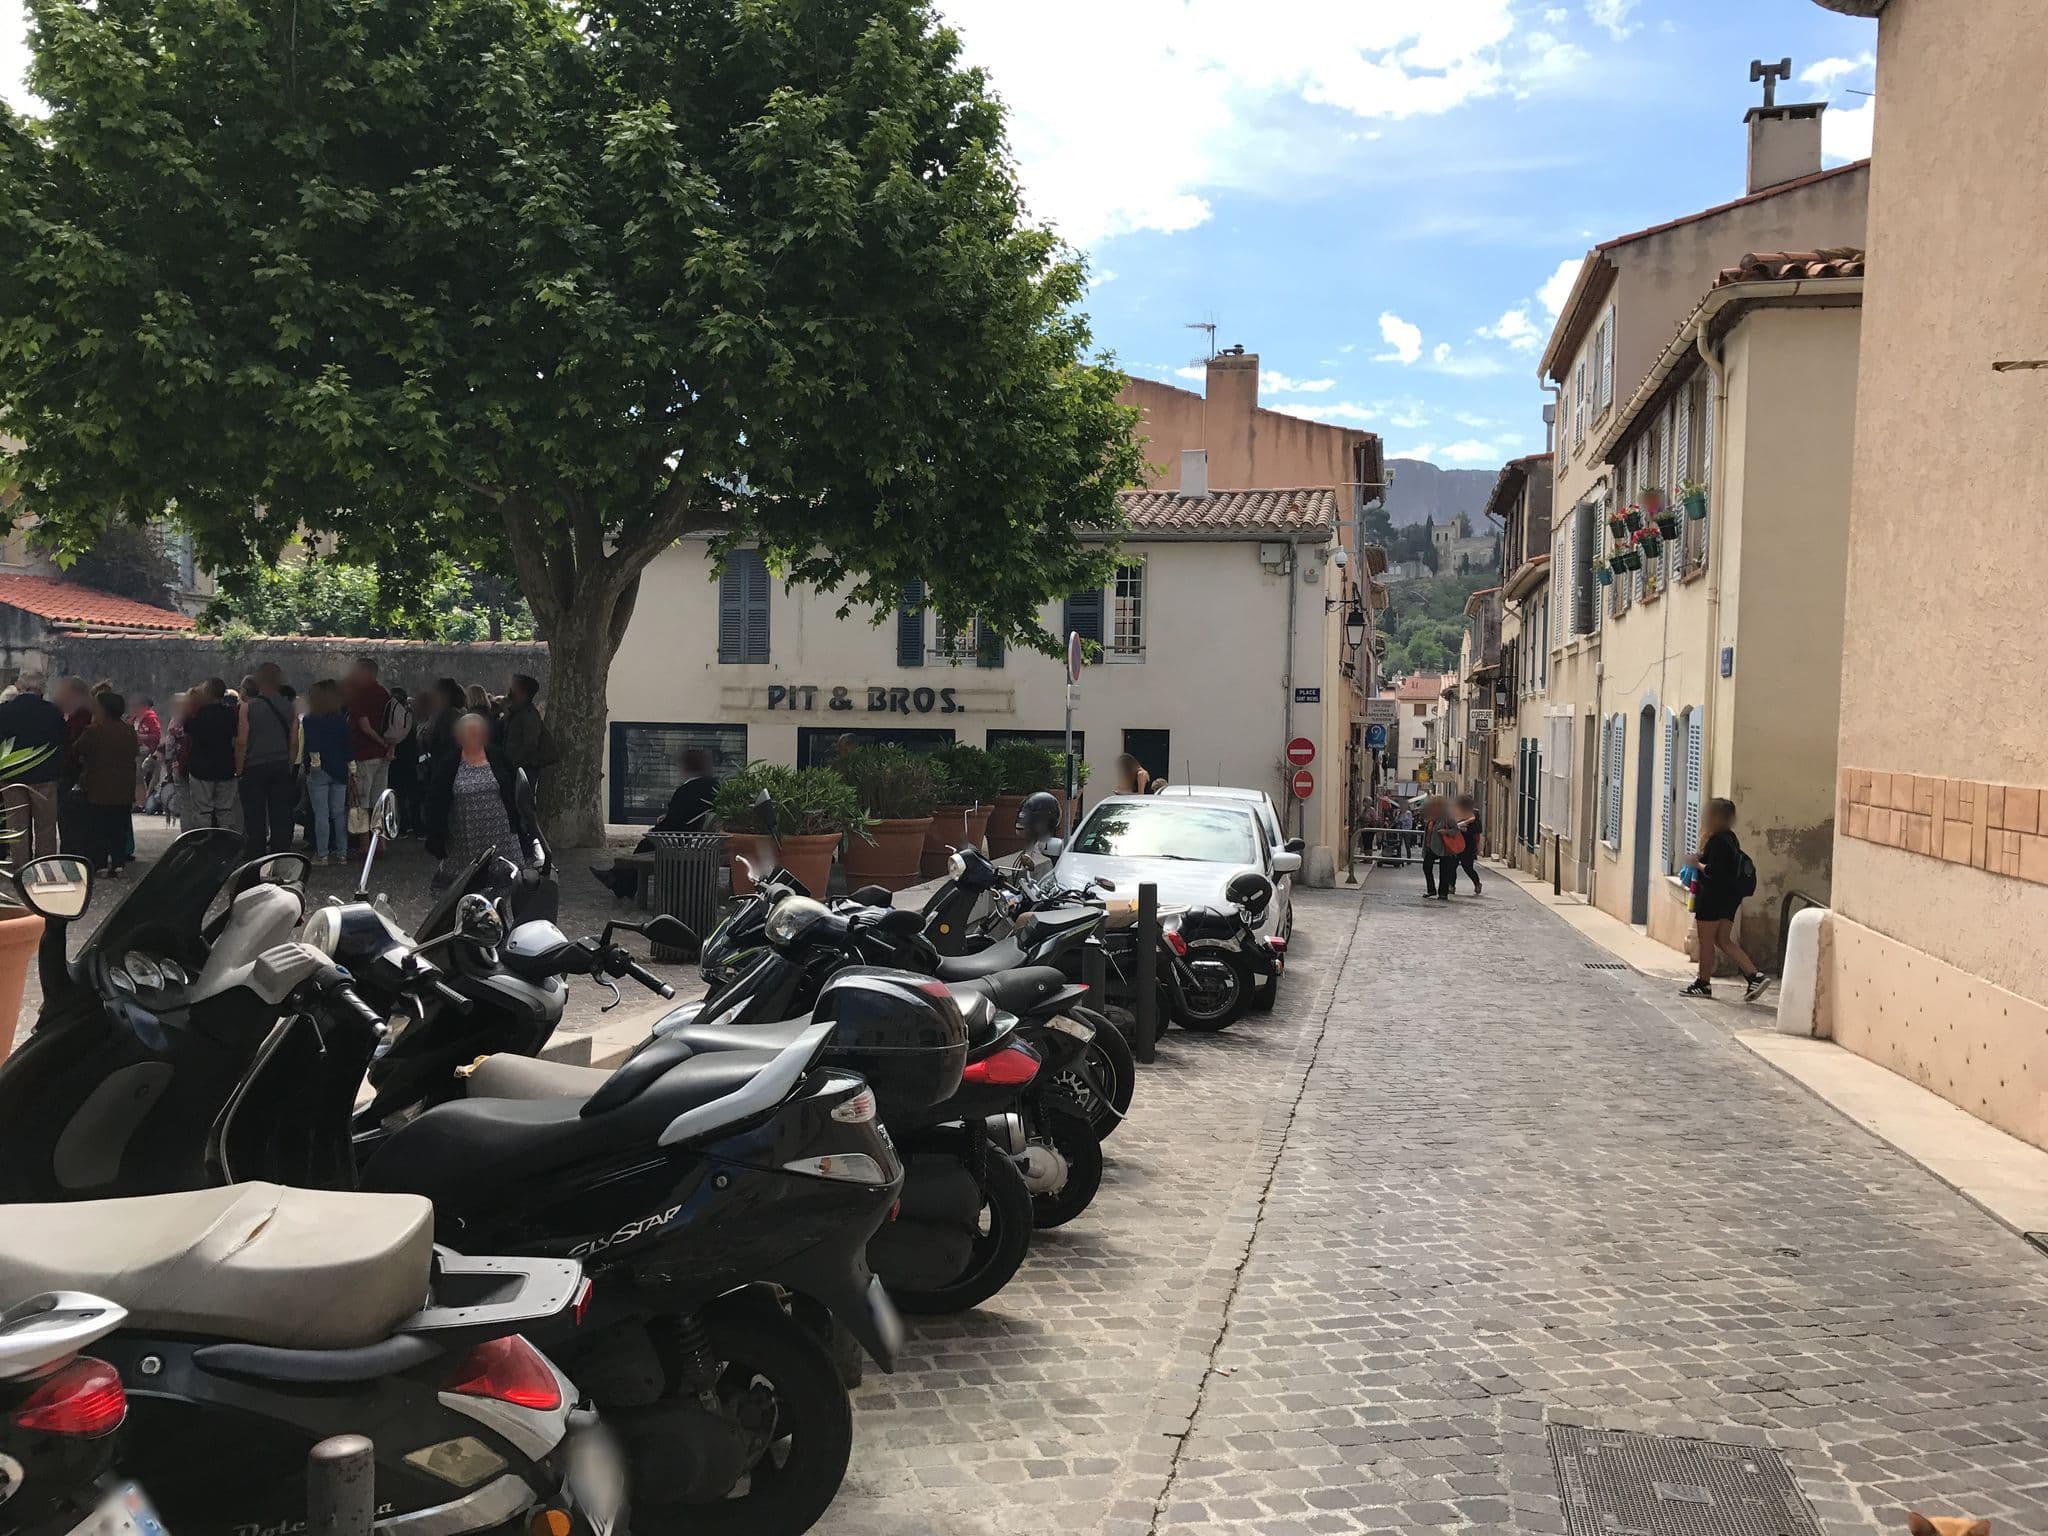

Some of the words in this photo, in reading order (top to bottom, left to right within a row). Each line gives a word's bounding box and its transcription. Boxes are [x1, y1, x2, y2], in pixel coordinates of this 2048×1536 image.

[768, 685, 818, 710] PIT
[829, 686, 853, 710] &
[867, 686, 965, 715] BROS.
[1471, 710, 1493, 719] COIFFURE
